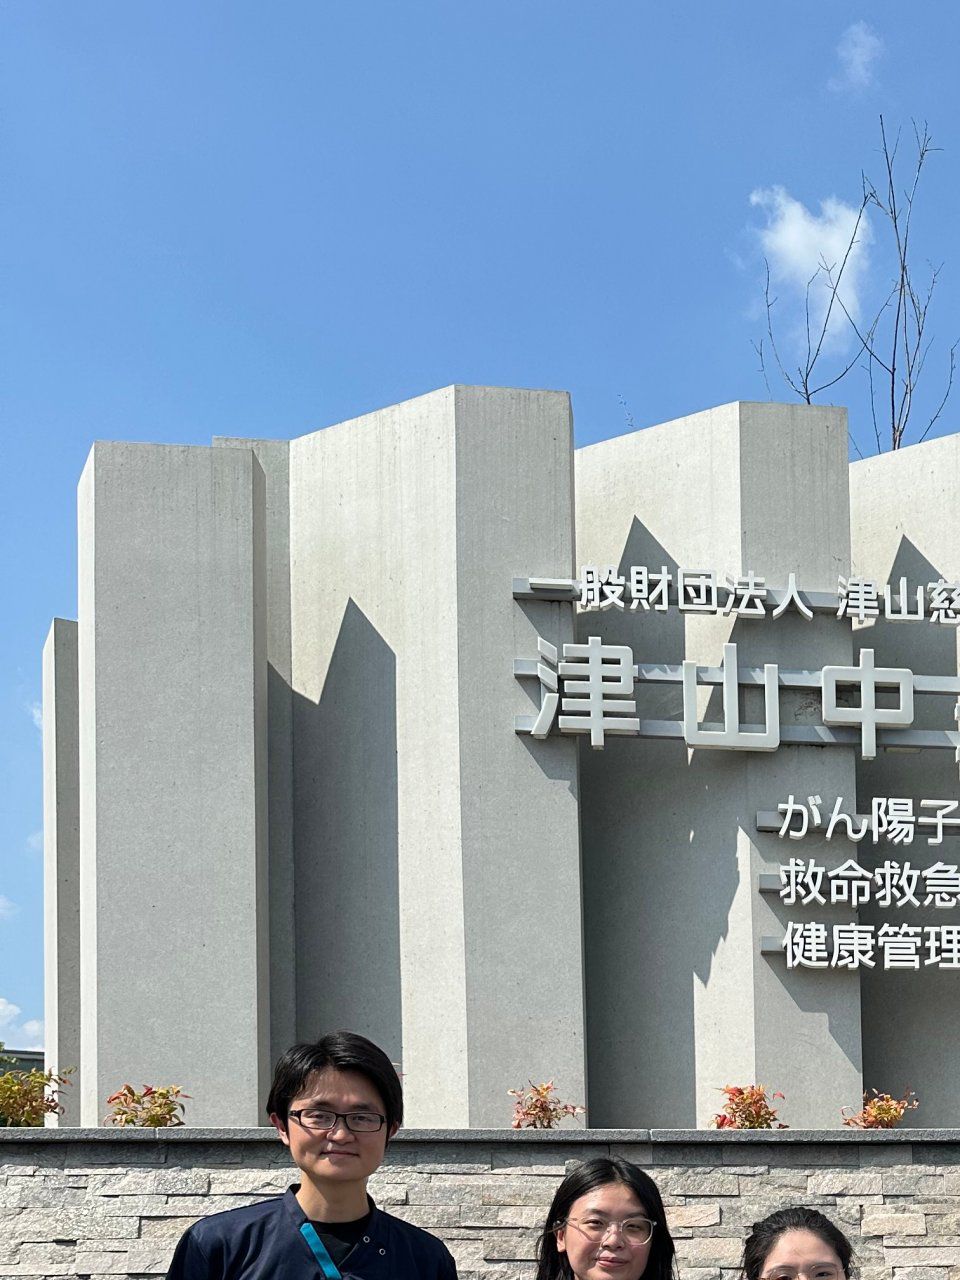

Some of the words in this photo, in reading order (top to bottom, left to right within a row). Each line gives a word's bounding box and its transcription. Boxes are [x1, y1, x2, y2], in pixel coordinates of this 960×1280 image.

[528, 565, 814, 620] 一般財団法人
